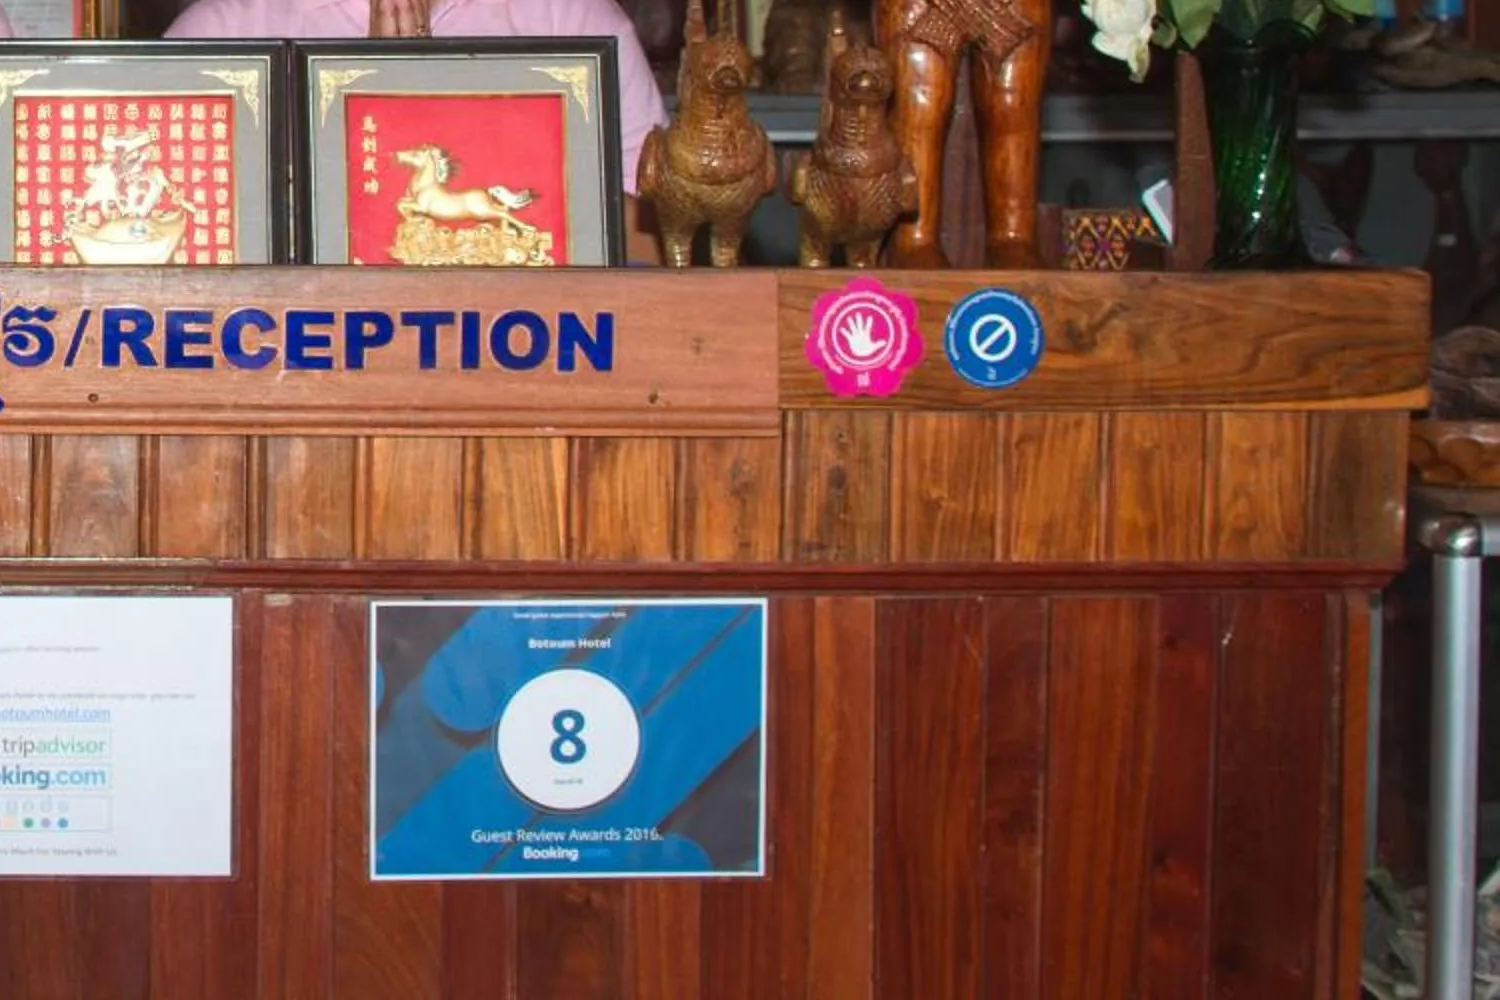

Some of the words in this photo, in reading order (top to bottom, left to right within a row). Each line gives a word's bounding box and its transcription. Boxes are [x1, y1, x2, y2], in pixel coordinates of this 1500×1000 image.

[579, 637, 611, 649] Hotel
[2, 735, 106, 757] tripadvisor
[550, 709, 587, 765] 8
[471, 829, 513, 844] Guest
[517, 829, 565, 843] Review
[569, 828, 621, 843] Awards
